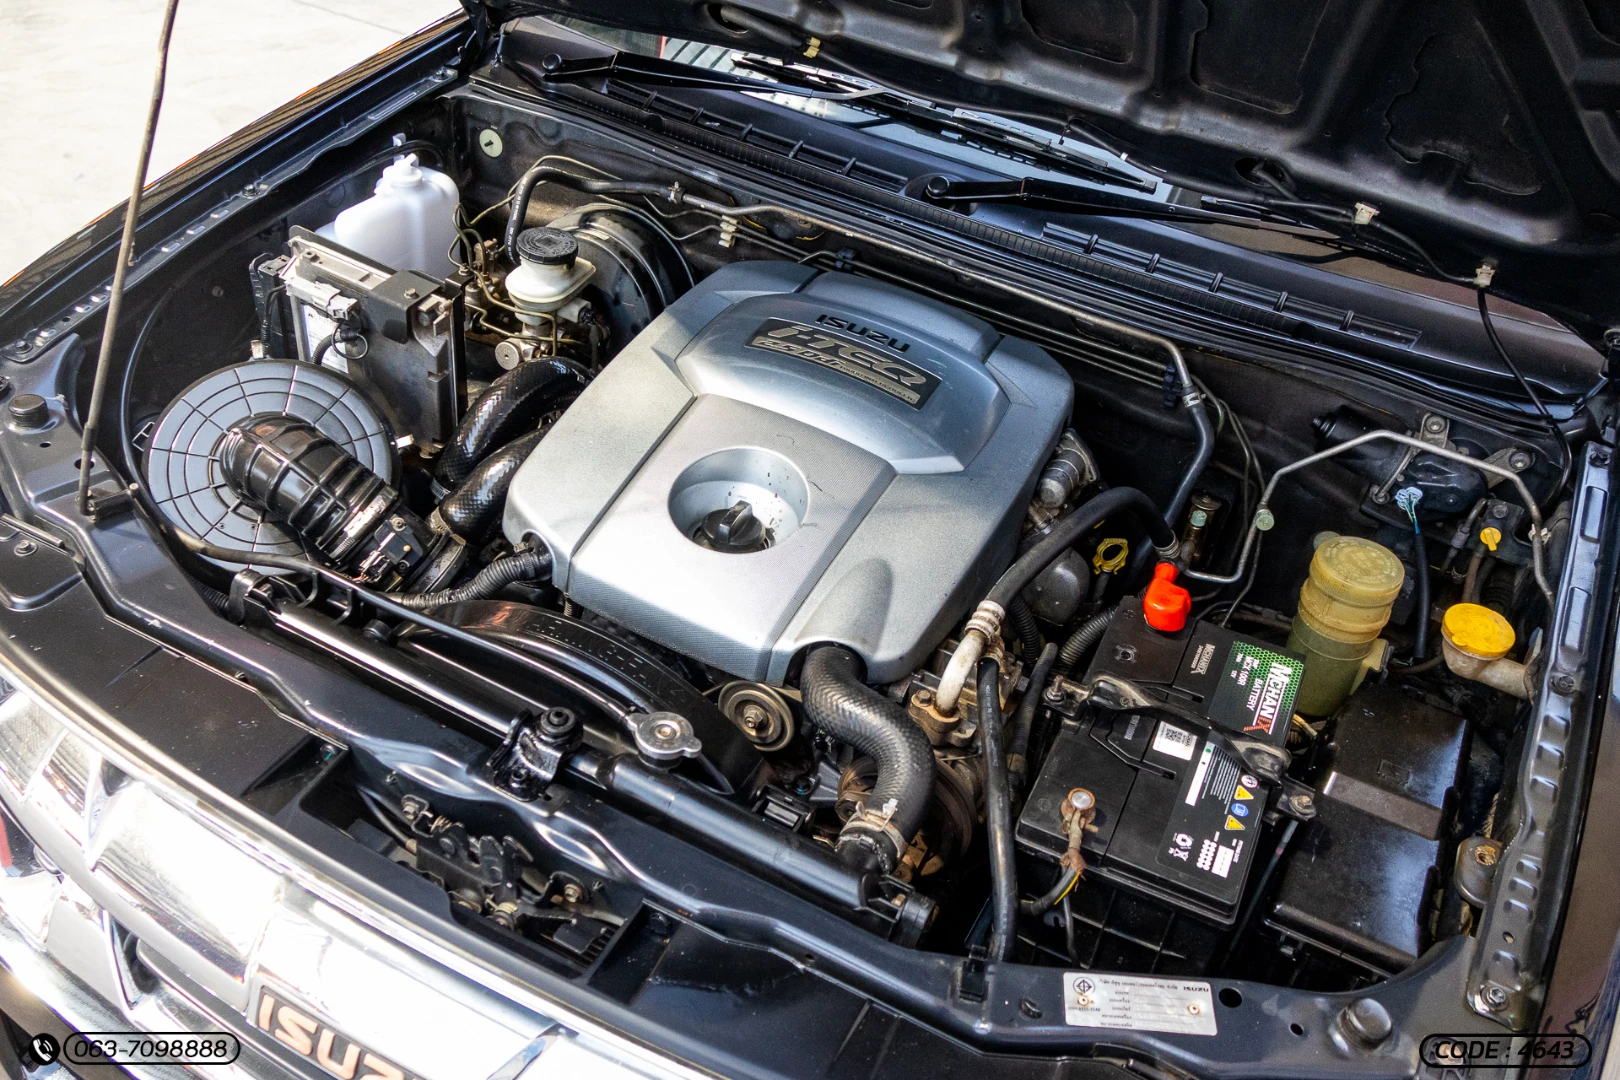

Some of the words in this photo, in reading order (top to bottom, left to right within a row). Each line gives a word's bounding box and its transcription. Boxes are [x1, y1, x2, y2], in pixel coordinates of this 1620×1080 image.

[815, 314, 911, 353] ISUZU
[1243, 662, 1292, 735] MCHANIX
[1246, 678, 1264, 711] BATTERY
[259, 994, 414, 1080] ISUZ
